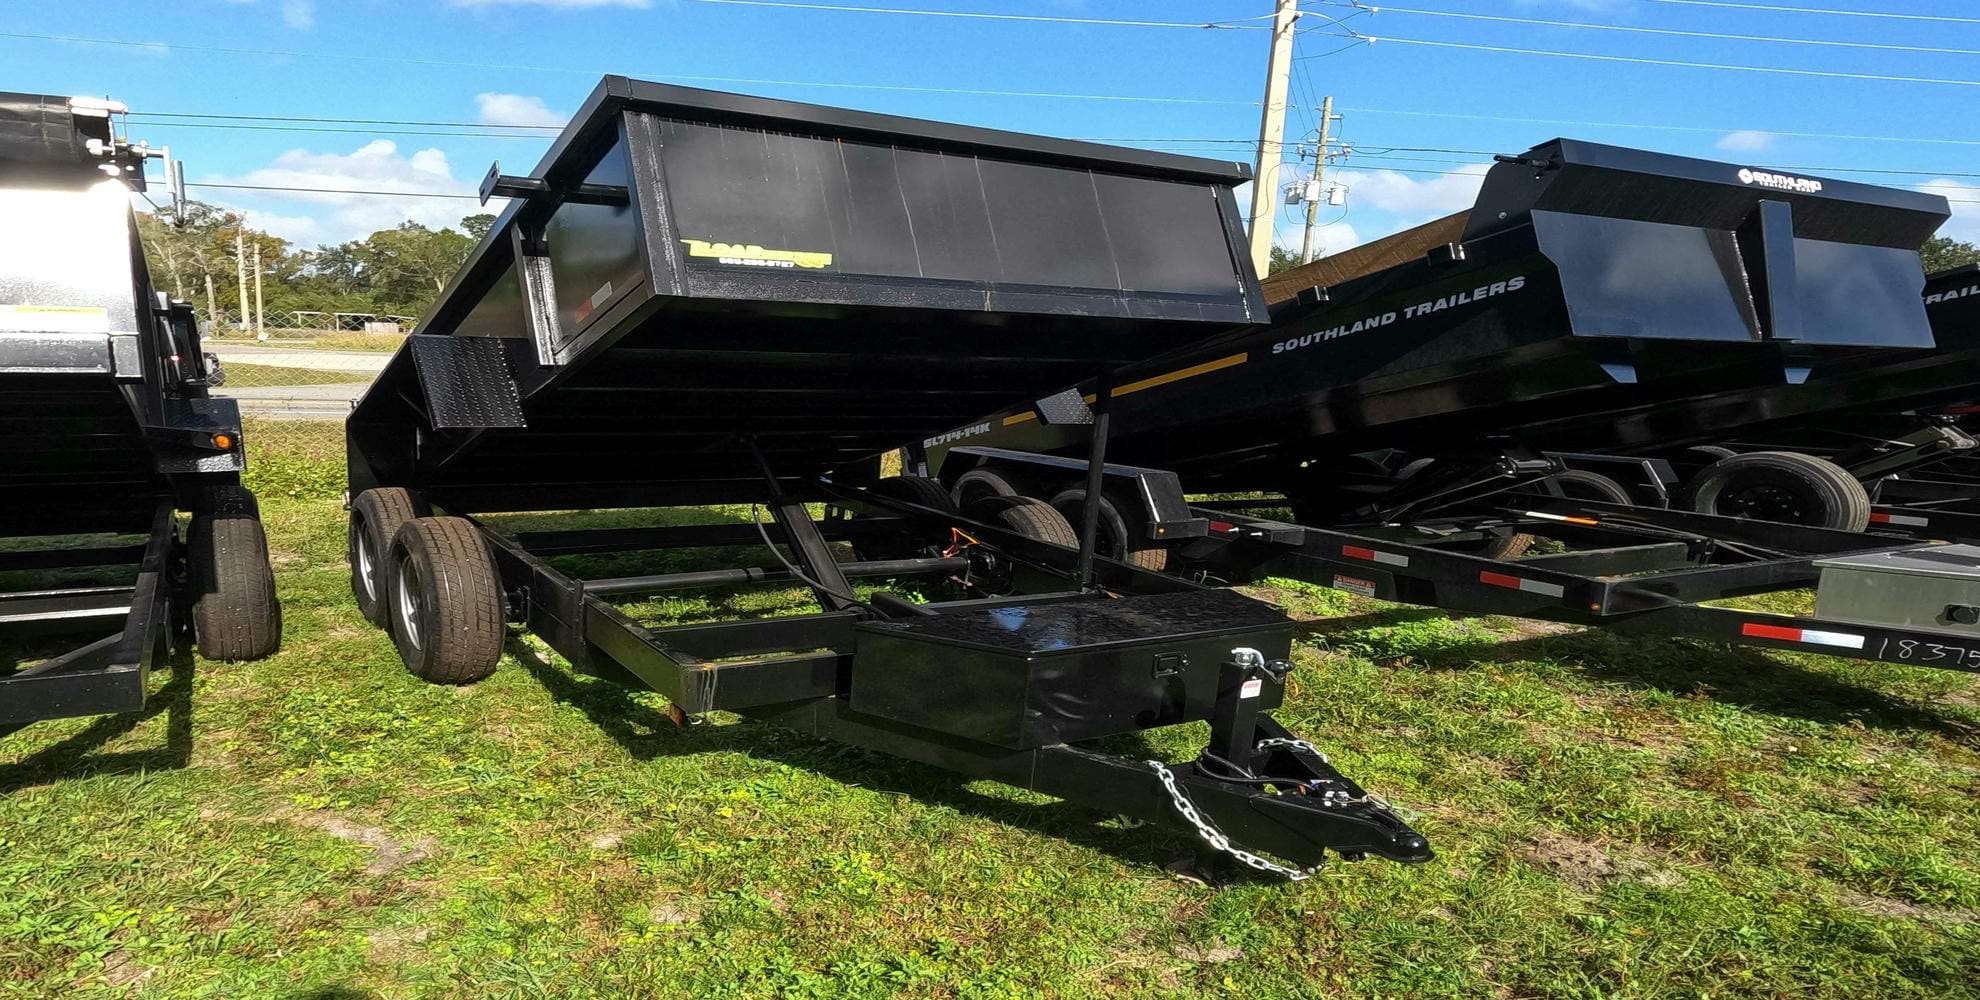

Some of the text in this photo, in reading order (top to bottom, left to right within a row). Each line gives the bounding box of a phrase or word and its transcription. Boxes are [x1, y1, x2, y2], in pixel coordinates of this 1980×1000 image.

[1753, 172, 1822, 191] SOUTHLAND
[1923, 285, 1980, 304] RAIL
[1272, 276, 1526, 354] SOUTHLAND TRAILERS
